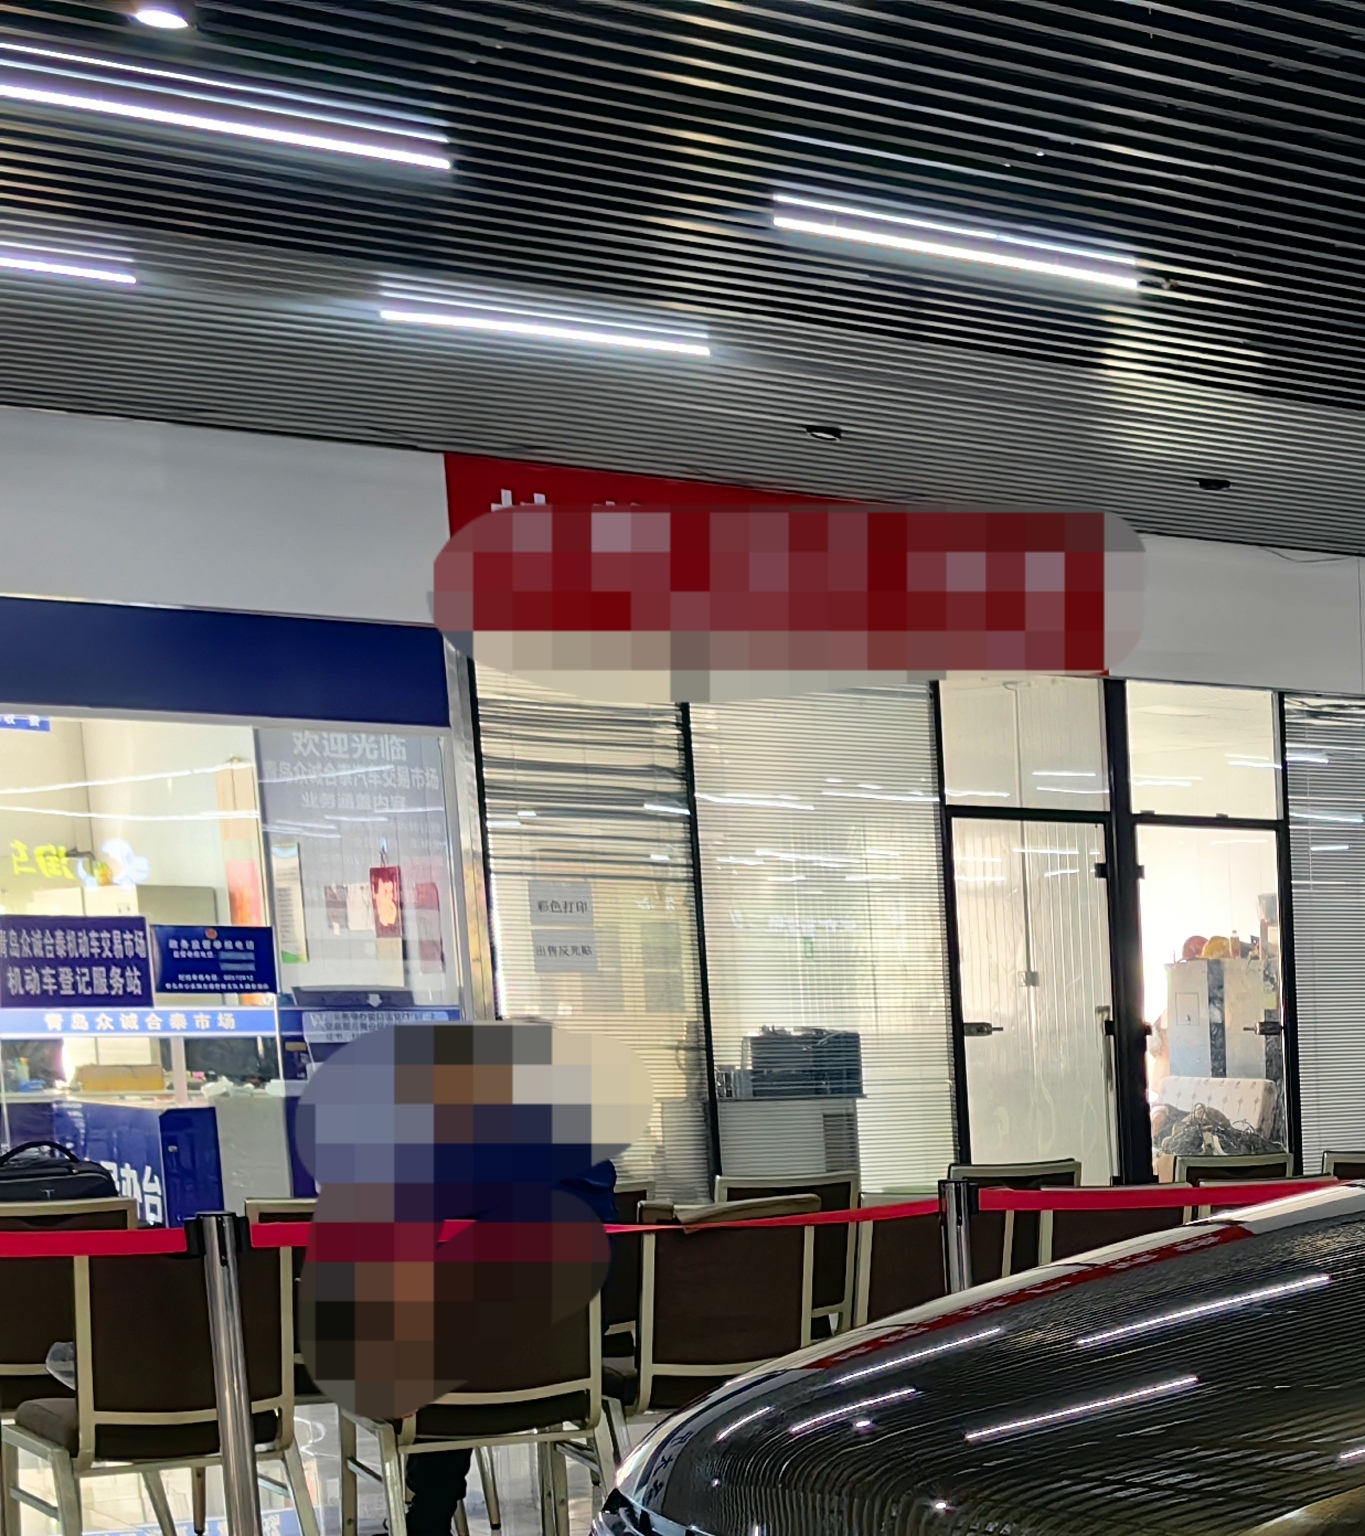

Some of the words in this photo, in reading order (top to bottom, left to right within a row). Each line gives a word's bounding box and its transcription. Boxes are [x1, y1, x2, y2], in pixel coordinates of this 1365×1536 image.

[292, 730, 407, 761] 欢迎光临
[537, 900, 588, 913] 彩色打印
[7, 965, 142, 995] 机动车登记服务站
[44, 1012, 236, 1031] 青岛众诚合泰市场
